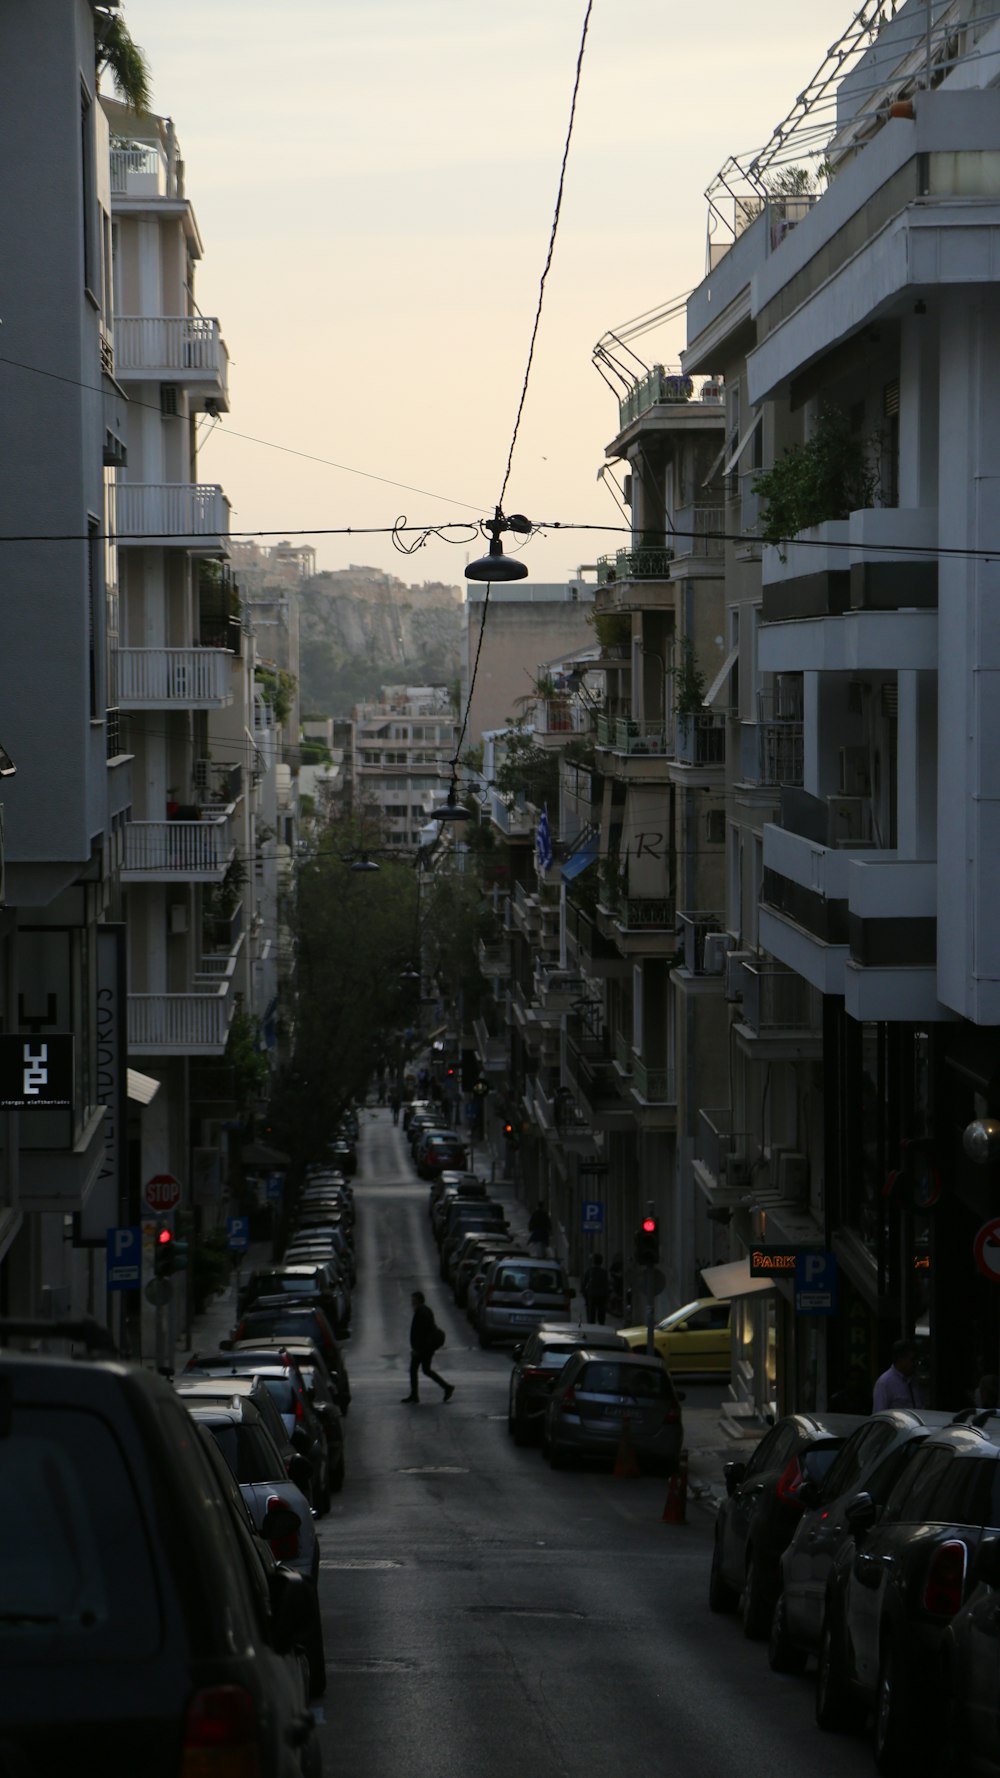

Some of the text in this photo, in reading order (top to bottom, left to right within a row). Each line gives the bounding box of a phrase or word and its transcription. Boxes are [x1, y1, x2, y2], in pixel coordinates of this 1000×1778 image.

[634, 832, 663, 860] R
[146, 1183, 179, 1202] STOP
[586, 1204, 600, 1221] P
[231, 1219, 244, 1235] P
[114, 1229, 134, 1257] P
[804, 1255, 827, 1282] P
